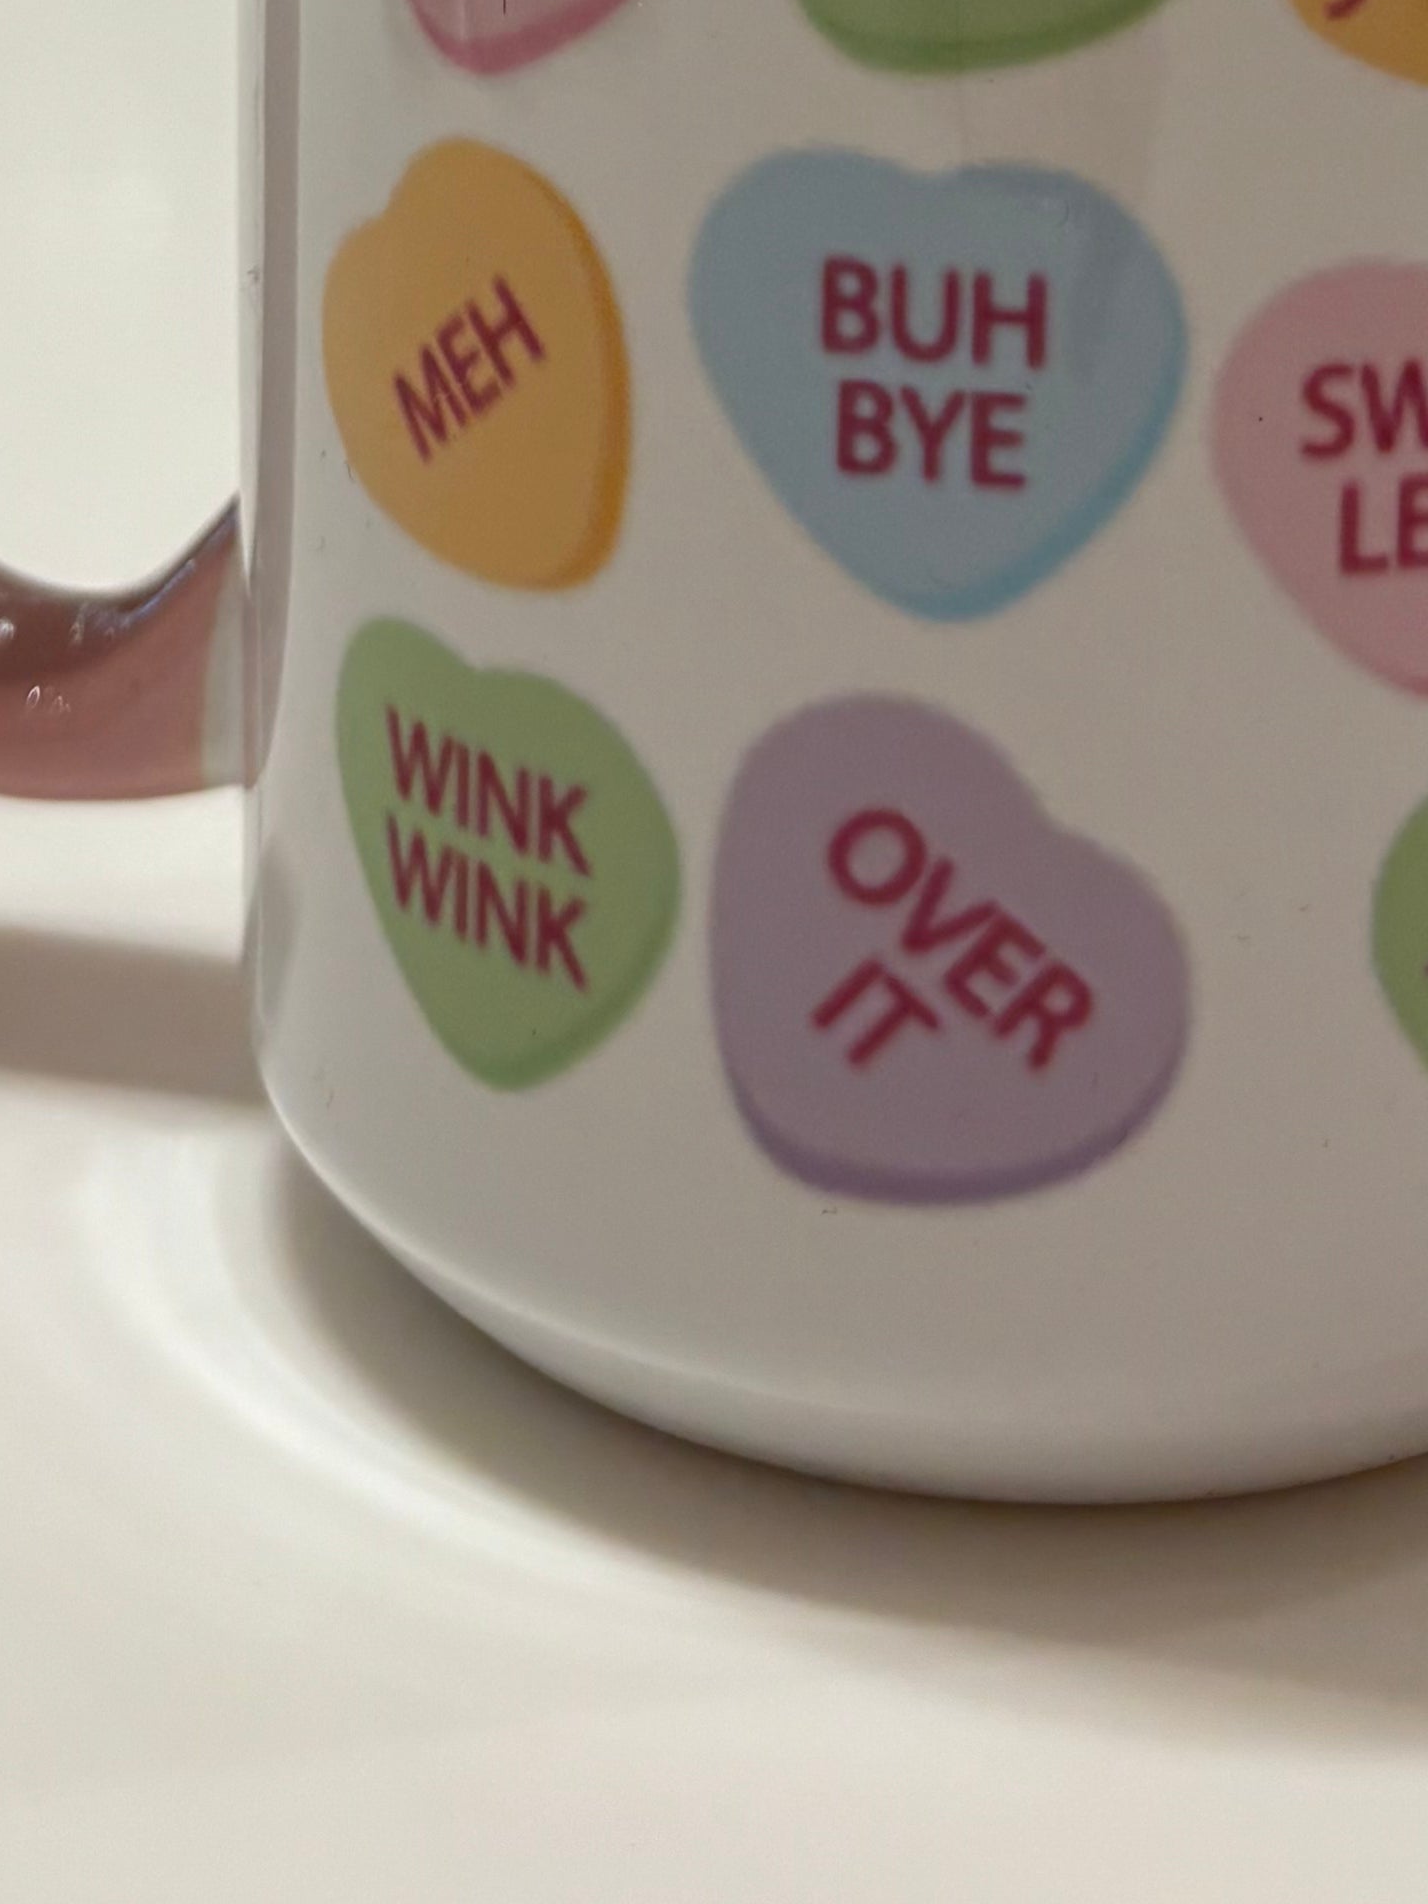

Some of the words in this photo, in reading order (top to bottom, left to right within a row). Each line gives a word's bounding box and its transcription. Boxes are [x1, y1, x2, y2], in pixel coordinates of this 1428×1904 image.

[392, 275, 548, 464] MEH
[818, 255, 1050, 372] BUH
[833, 378, 1027, 493] BYE
[385, 702, 592, 877] WINK
[386, 814, 589, 991] WINK
[824, 807, 1096, 1074] OVER
[810, 958, 943, 1071] IT
